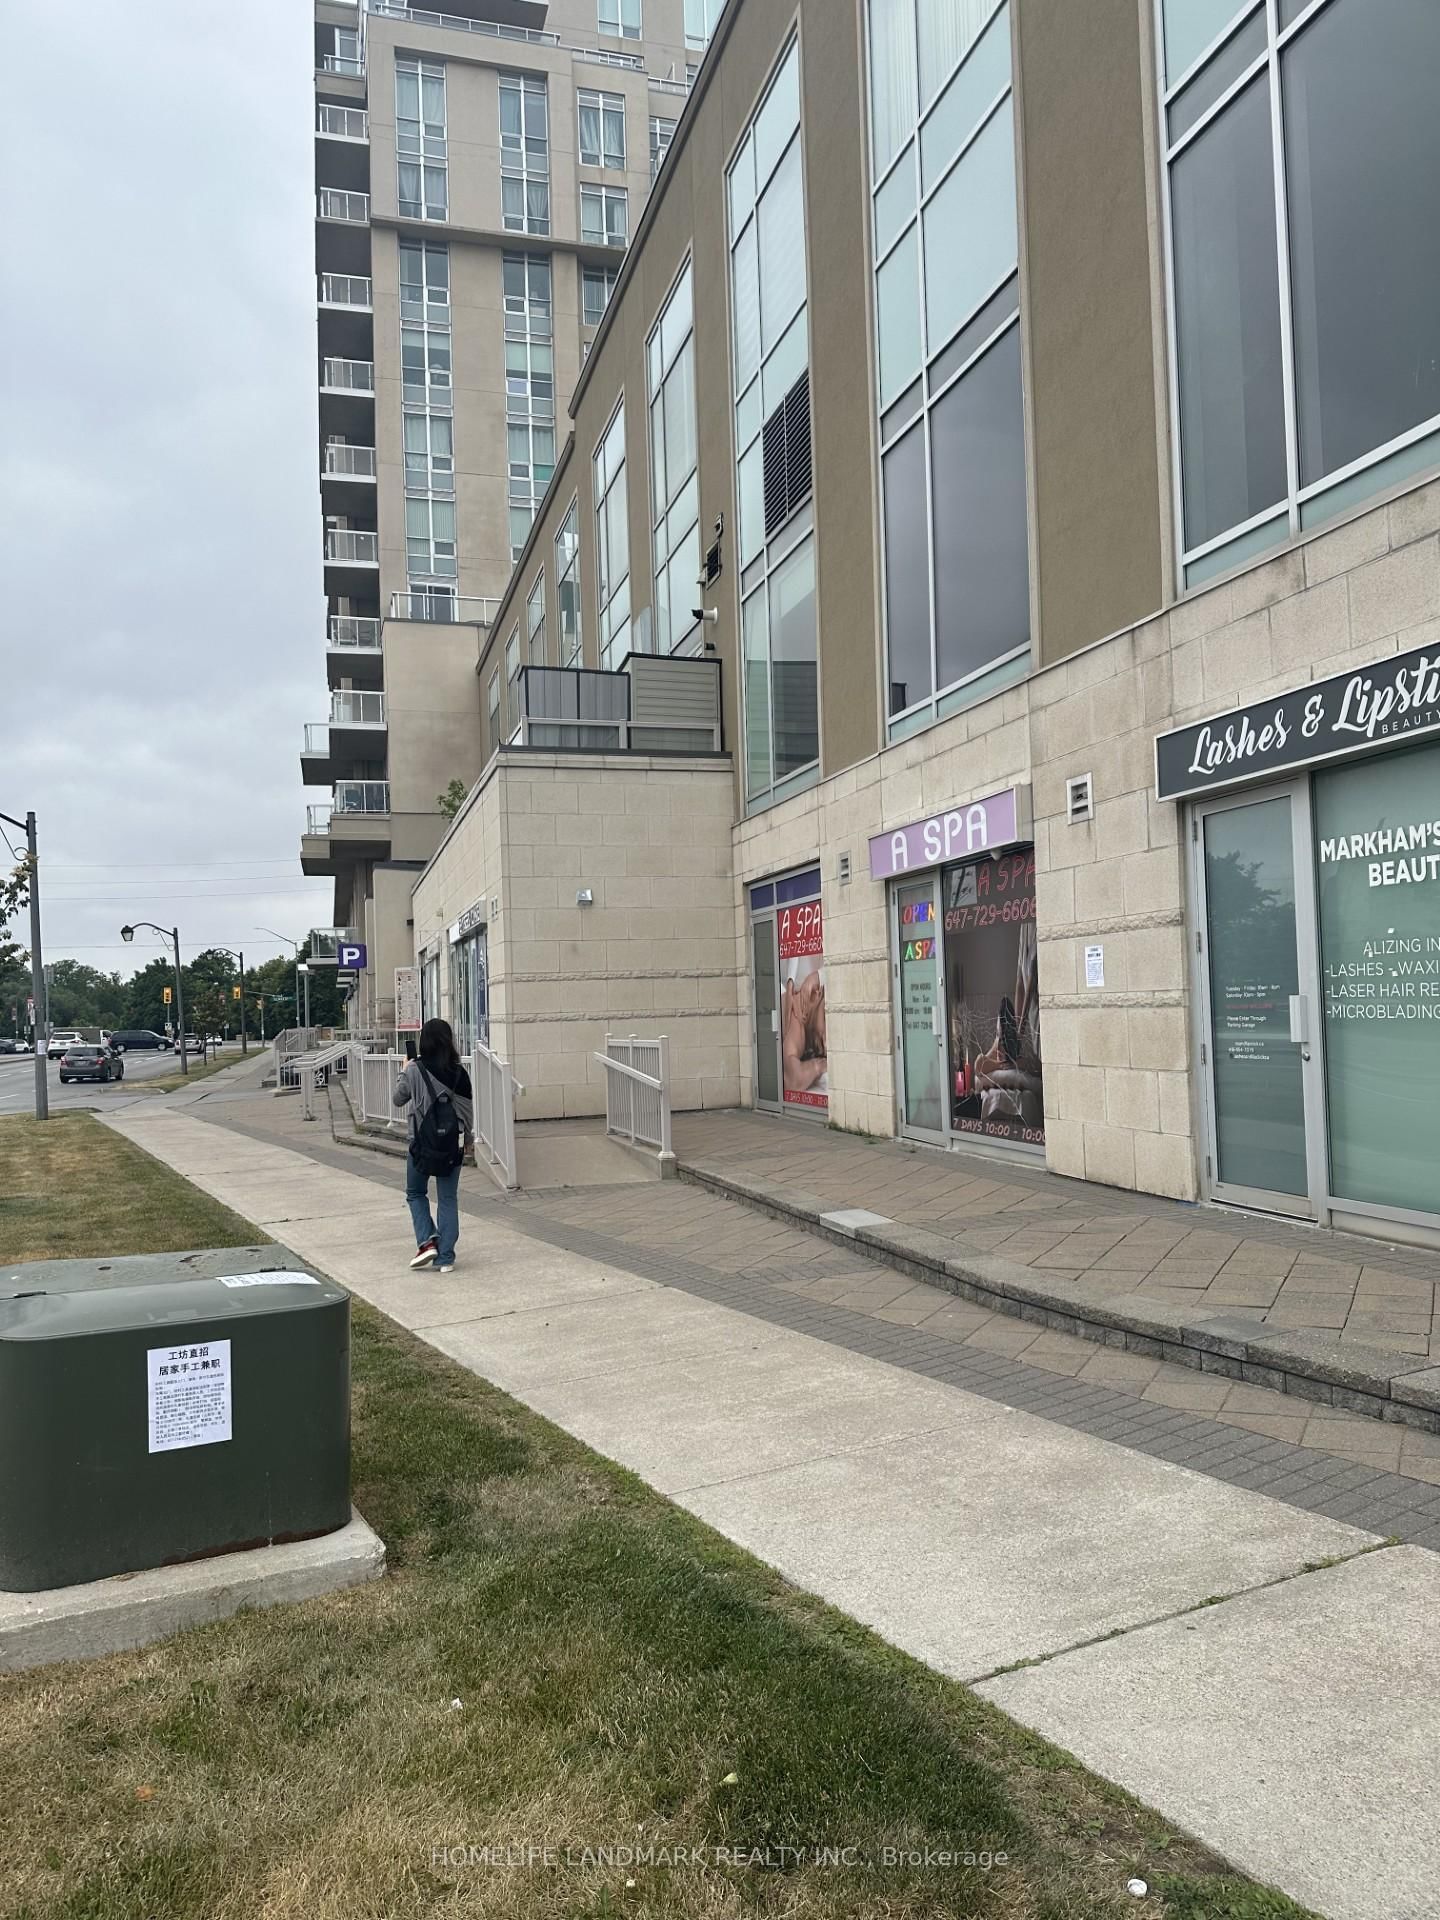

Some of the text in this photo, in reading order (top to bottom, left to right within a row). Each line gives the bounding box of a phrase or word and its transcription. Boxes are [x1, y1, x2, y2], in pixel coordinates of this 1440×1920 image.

[1188, 655, 1440, 775] Lashes & Lipsti
[891, 804, 988, 871] A SPA
[1320, 820, 1440, 863] MARKHAM'S
[978, 862, 990, 896] A
[781, 904, 821, 939] A SPA
[903, 902, 935, 924] OPEN
[343, 948, 360, 965] P
[780, 937, 822, 956] 647-729-660
[1379, 982, 1416, 997] HAIR
[1420, 981, 1440, 997] RE
[953, 1118, 959, 1128] 7
[961, 1119, 982, 1132] DAYS
[985, 1122, 1010, 1137] 10:00
[159, 1358, 221, 1377] 居家手工兼职
